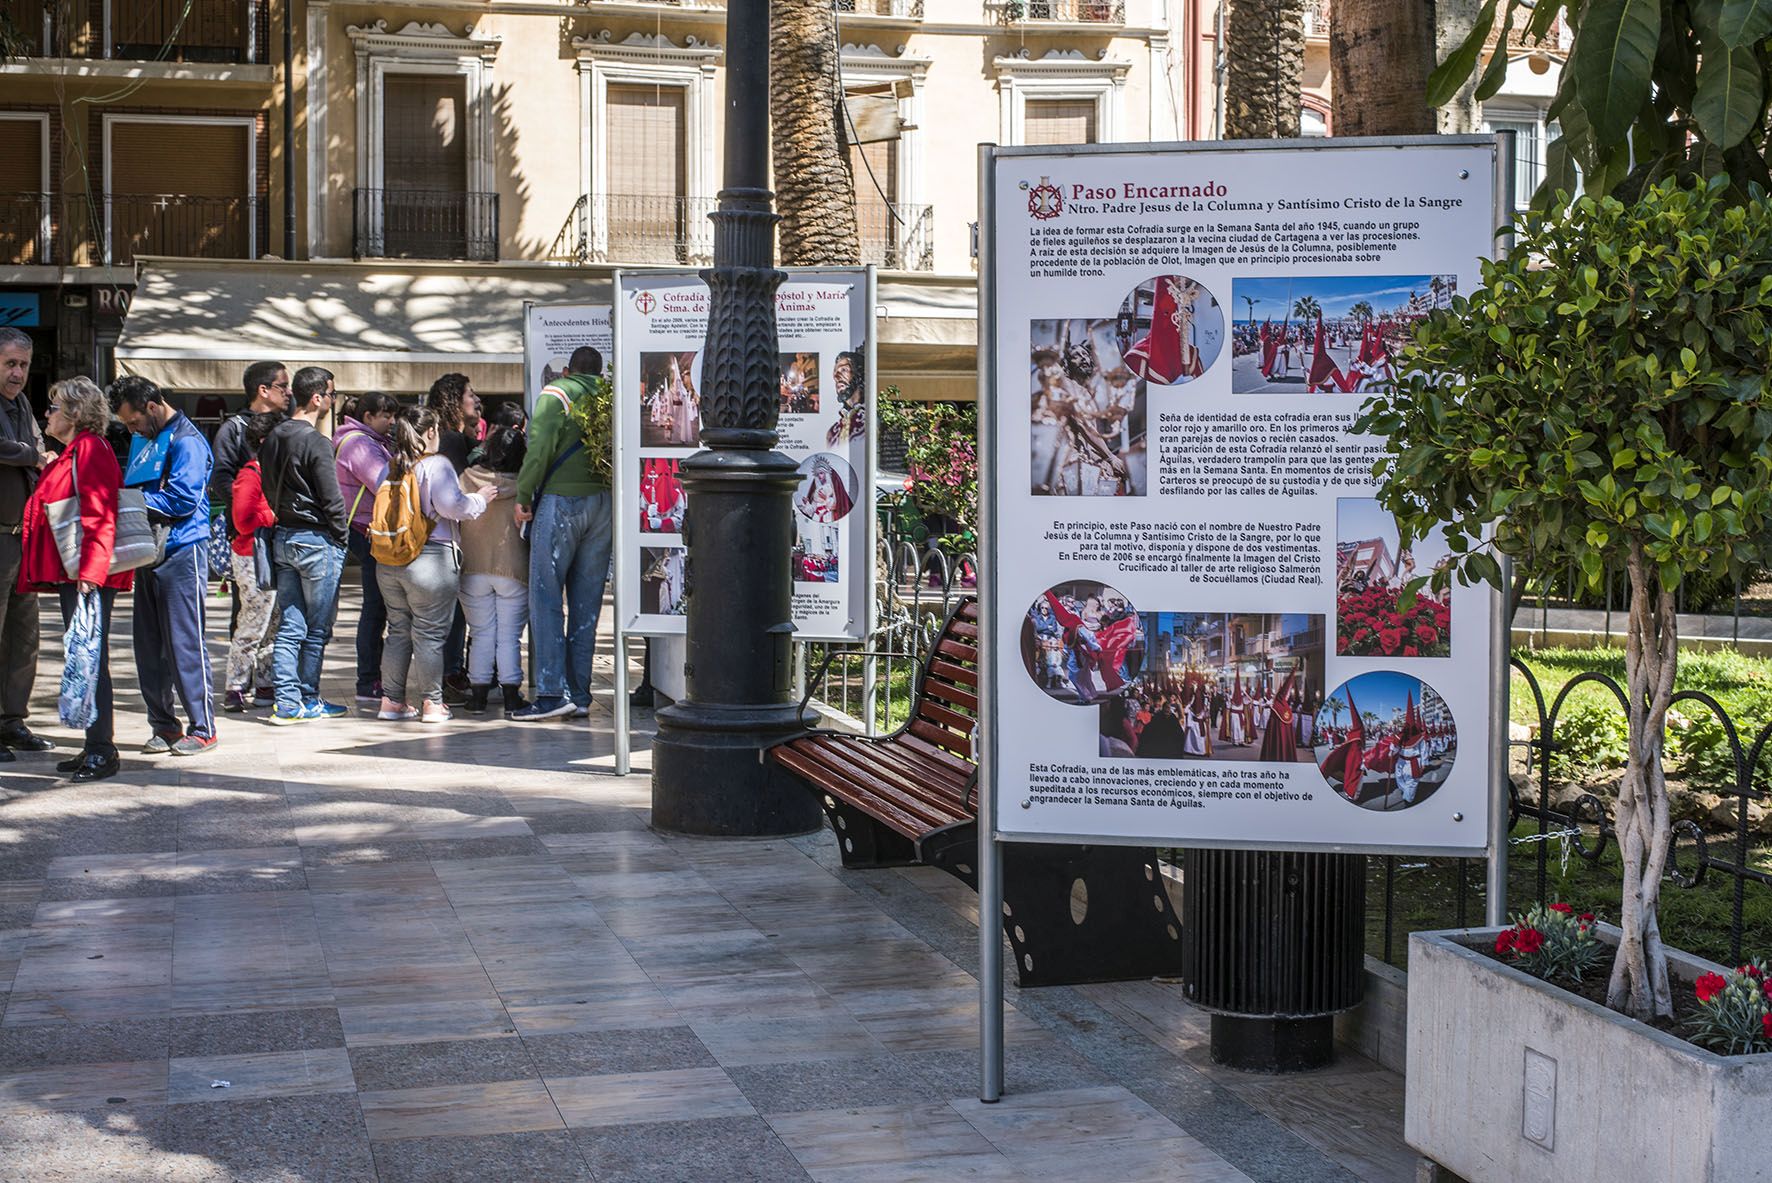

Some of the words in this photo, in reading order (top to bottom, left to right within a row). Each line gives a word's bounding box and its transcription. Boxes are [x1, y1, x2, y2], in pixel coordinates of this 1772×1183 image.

[1072, 183, 1116, 199] Paso
[1123, 181, 1227, 198] Encarnado
[1068, 203, 1098, 213] Ntro.
[1102, 202, 1136, 213] Padre
[1139, 201, 1171, 212] Jesus
[1174, 201, 1189, 211] de
[1192, 201, 1203, 211] la
[1207, 200, 1263, 211] Columna
[1266, 202, 1274, 212] y
[1277, 198, 1340, 209] Santísimo
[1343, 197, 1381, 208] Cristo
[1384, 197, 1400, 207] de
[1403, 197, 1415, 207] la
[1418, 196, 1462, 209] Sangre
[1030, 226, 1040, 235] La
[1042, 226, 1060, 235] idea
[1062, 225, 1073, 235] de
[1075, 225, 1104, 234] formar
[1106, 225, 1124, 234] esta
[1126, 224, 1164, 233] Cofradía
[1166, 226, 1191, 235] surge
[1206, 223, 1214, 232] la
[1216, 222, 1252, 232] Semana
[1254, 222, 1279, 231] Santa
[1281, 221, 1295, 231] del
[1297, 221, 1314, 230] año
[1317, 221, 1340, 231] 1945,
[1342, 220, 1376, 229] cuando
[1392, 221, 1419, 231] grupo
[1029, 236, 1040, 246] de
[1042, 236, 1066, 245] fieles
[1068, 235, 1110, 247] aguileños
[1124, 234, 1177, 246] desplazaron
[1187, 234, 1195, 243] la
[1197, 233, 1226, 243] vecina
[1228, 232, 1258, 242] ciudad
[1260, 232, 1272, 242] de
[1274, 231, 1319, 244] Cartagena
[1346, 231, 1360, 240] las
[1362, 230, 1420, 242] procesiones.
[1029, 247, 1036, 256] A
[1038, 246, 1054, 256] raíz
[1056, 246, 1067, 255] de
[1069, 247, 1087, 255] esta
[1089, 245, 1126, 255] decisión
[1141, 244, 1179, 256] adquiere
[1181, 244, 1189, 253] la
[1191, 244, 1223, 255] Imagen
[1226, 243, 1237, 253] de
[1239, 243, 1265, 252] Jesús
[1267, 243, 1278, 252] de
[1281, 243, 1289, 252] la
[1291, 242, 1334, 253] Columna,
[1336, 241, 1396, 253] posiblemente
[663, 292, 705, 302] Cofradía
[774, 290, 805, 303] póstol
[807, 293, 814, 302] y
[816, 290, 845, 300] María
[663, 303, 690, 313] Stma.
[692, 303, 705, 313] de
[778, 301, 816, 311] Ánimas
[543, 318, 590, 327] Antecedentes
[1181, 436, 1213, 444] parejas
[1215, 433, 1226, 442] de
[1228, 433, 1258, 442] novios
[1268, 433, 1296, 442] recién
[1298, 433, 1338, 442] casados.
[1159, 444, 1170, 453] La
[1172, 444, 1213, 455] aparición
[1215, 444, 1226, 453] de
[1228, 444, 1247, 453] esta
[1249, 444, 1287, 453] Cofradía
[1289, 444, 1322, 453] relanzó
[1324, 444, 1332, 453] el
[1334, 444, 1361, 453] sentir
[1159, 485, 1205, 494] desfilando
[1207, 488, 1222, 497] por
[1224, 486, 1237, 495] las
[1239, 486, 1265, 495] calles
[1268, 486, 1279, 495] de
[1281, 484, 1317, 497] Águilas.
[1053, 520, 1064, 529] En
[1066, 520, 1107, 531] principio,
[1109, 521, 1128, 530] este
[1130, 521, 1151, 530] Paso
[1154, 521, 1178, 530] nació
[1198, 521, 1206, 530] el
[1208, 521, 1242, 530] nombre
[1244, 522, 1255, 530] de
[1257, 522, 1293, 531] Nuestro
[1295, 522, 1321, 531] Padre
[1043, 530, 1068, 539] Jesús
[1070, 530, 1081, 539] de
[1083, 531, 1091, 540] la
[1093, 531, 1132, 540] Columna
[1133, 533, 1139, 542] y
[1141, 531, 1185, 540] Santísimo
[1187, 531, 1214, 541] Cristo
[1215, 532, 1227, 541] de
[1229, 532, 1237, 541] la
[1239, 532, 1273, 543] Sangre,
[1276, 534, 1291, 543] por
[1293, 532, 1302, 541] lo
[1304, 535, 1320, 543] que
[1189, 573, 1200, 582] de
[1202, 573, 1258, 583] Socuéllamos
[1260, 574, 1295, 585] (Ciudad
[1297, 574, 1323, 585] Real).
[1029, 763, 1048, 772] Esta
[1050, 763, 1088, 774] Cofradía,
[1108, 765, 1119, 774] de
[1121, 765, 1134, 775] las
[1136, 766, 1155, 775] más
[1156, 766, 1219, 778] emblemáticas,
[1221, 768, 1238, 778] año
[1240, 769, 1257, 778] tras
[1259, 769, 1276, 779] año
[1278, 770, 1289, 779] ha
[1029, 793, 1082, 805] engrandecer
[1084, 795, 1092, 804] la
[1094, 795, 1128, 805] Semana
[1130, 796, 1154, 806] Santa
[1156, 797, 1168, 806] de
[1169, 796, 1205, 810] Águilas.
